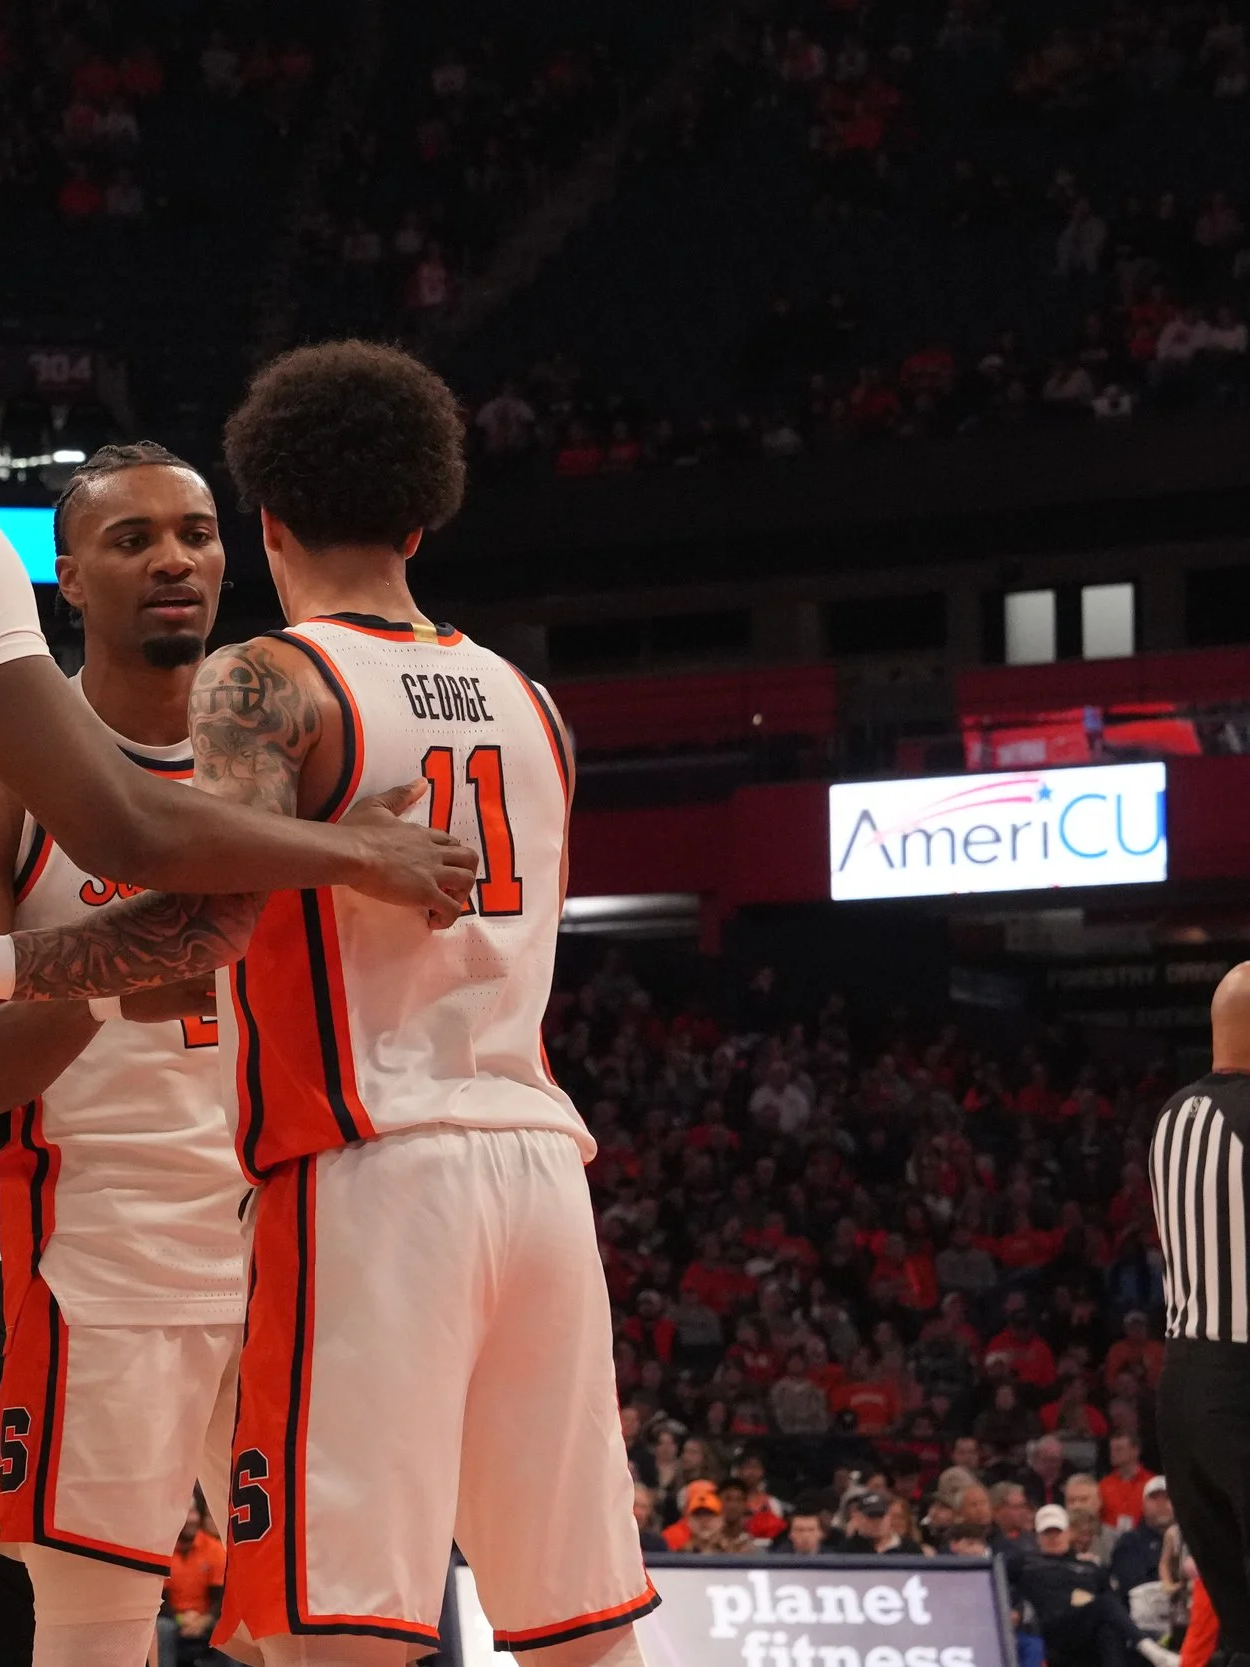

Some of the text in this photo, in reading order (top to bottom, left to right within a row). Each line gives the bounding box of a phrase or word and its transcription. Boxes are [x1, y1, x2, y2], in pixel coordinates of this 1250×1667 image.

[28, 353, 92, 383] 104
[401, 673, 495, 722] GEORGE
[421, 745, 523, 917] 11
[838, 793, 1164, 873] AmeriCU
[706, 1571, 932, 1638] planet
[742, 1631, 977, 1667] fitness
